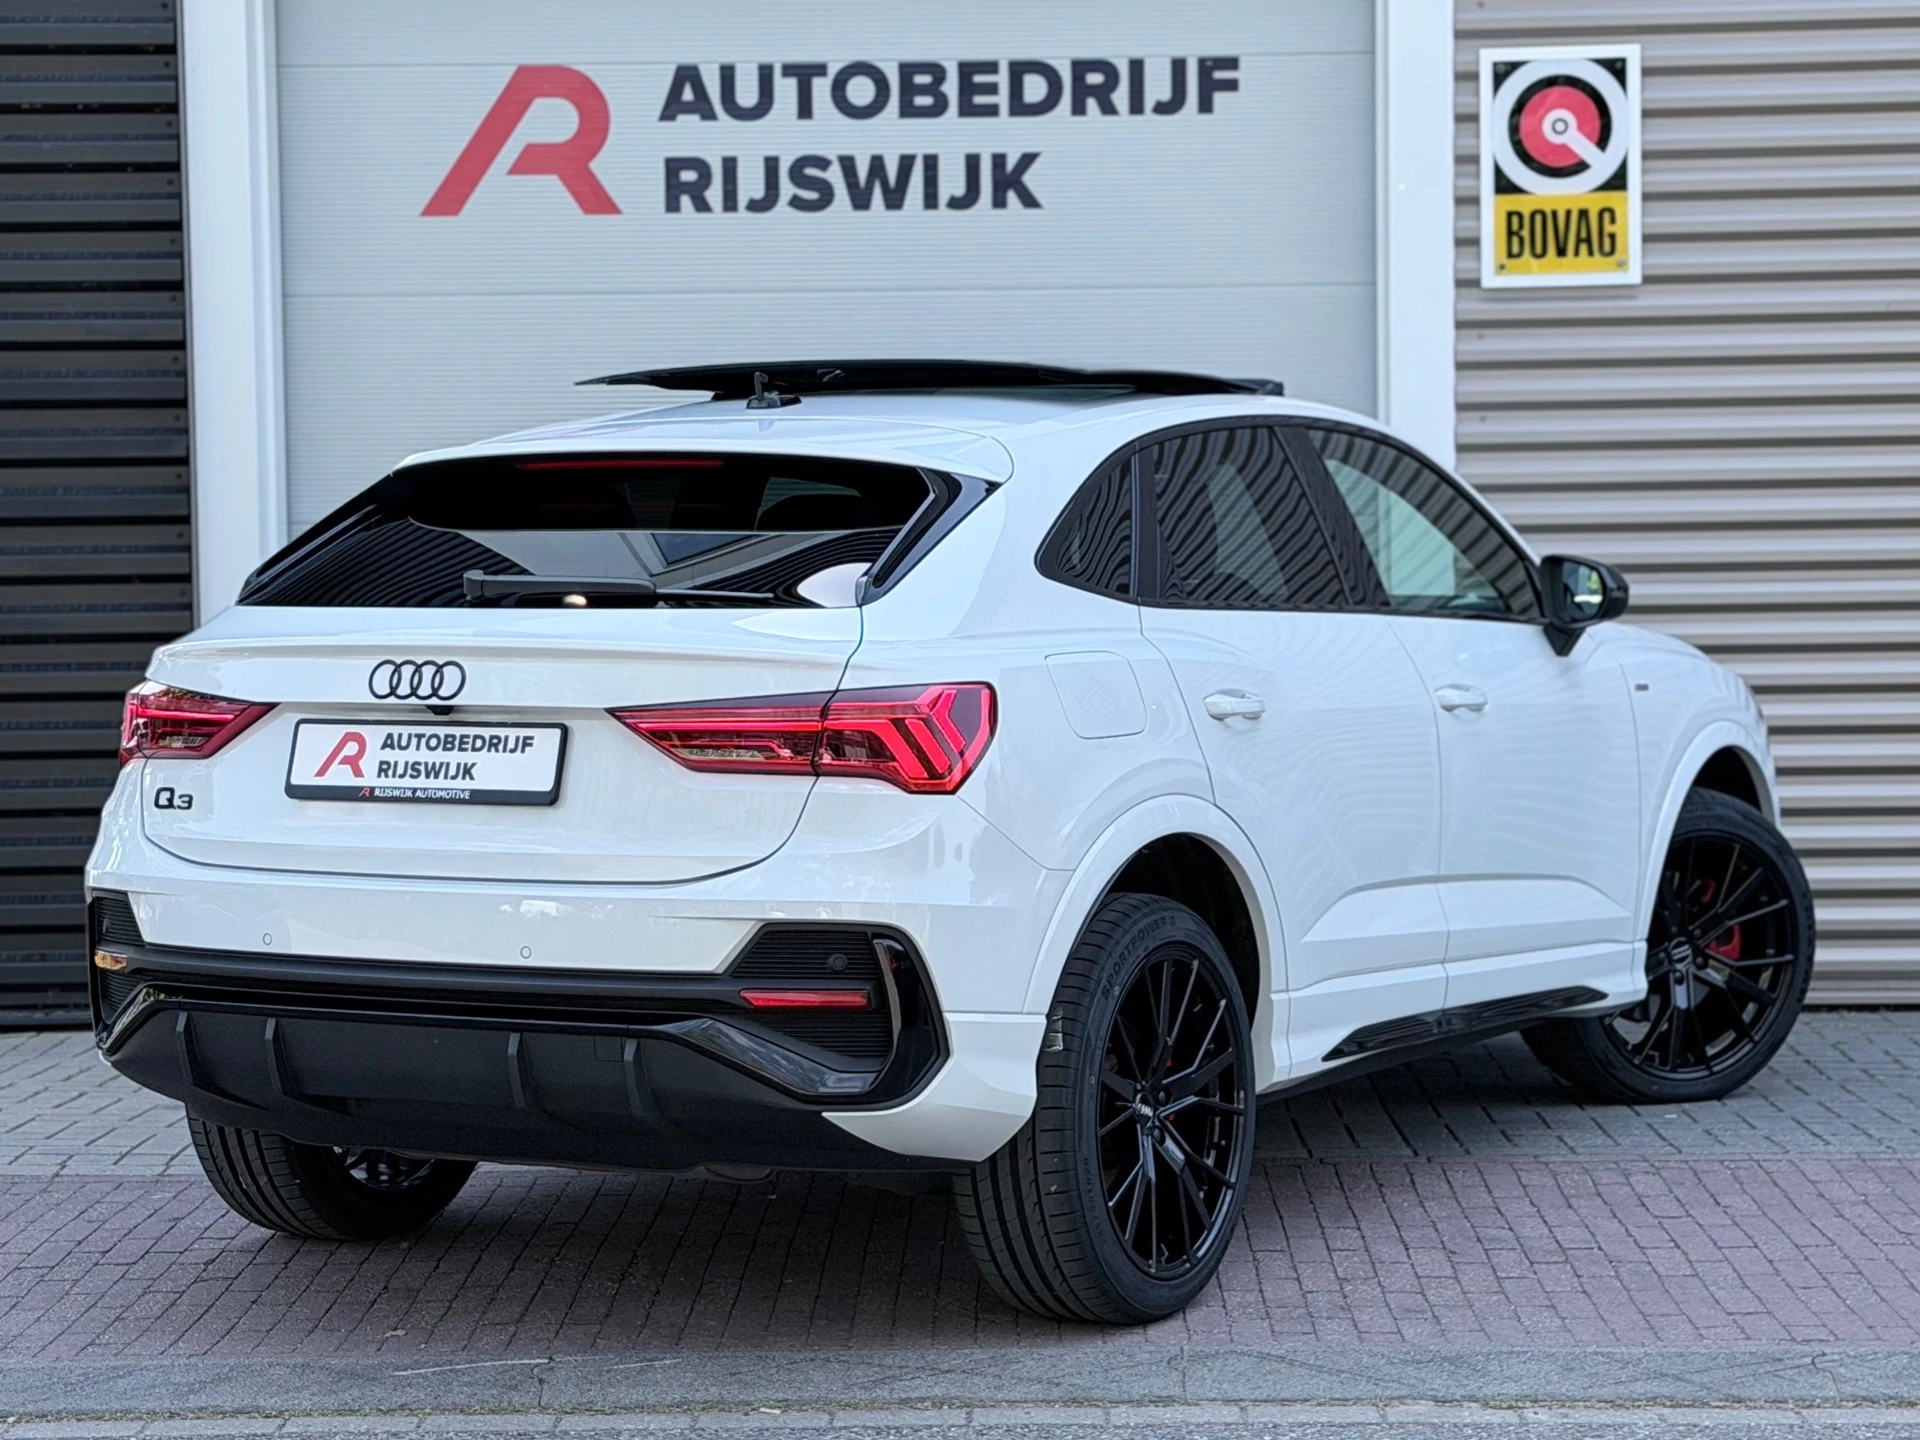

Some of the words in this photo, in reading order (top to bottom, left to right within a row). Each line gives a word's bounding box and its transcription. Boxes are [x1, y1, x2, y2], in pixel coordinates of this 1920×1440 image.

[658, 55, 1241, 122] AUTOBEDRIJF
[663, 152, 1044, 215] RIJSWIJK
[1505, 207, 1617, 260] BOVAG
[380, 732, 535, 754] AUTOBEDRIJF
[377, 760, 478, 781] RIJSWIJK
[154, 786, 194, 810] Q3
[374, 787, 414, 798] RIJSWIJK
[415, 789, 471, 799] AUTOMOTIVE
